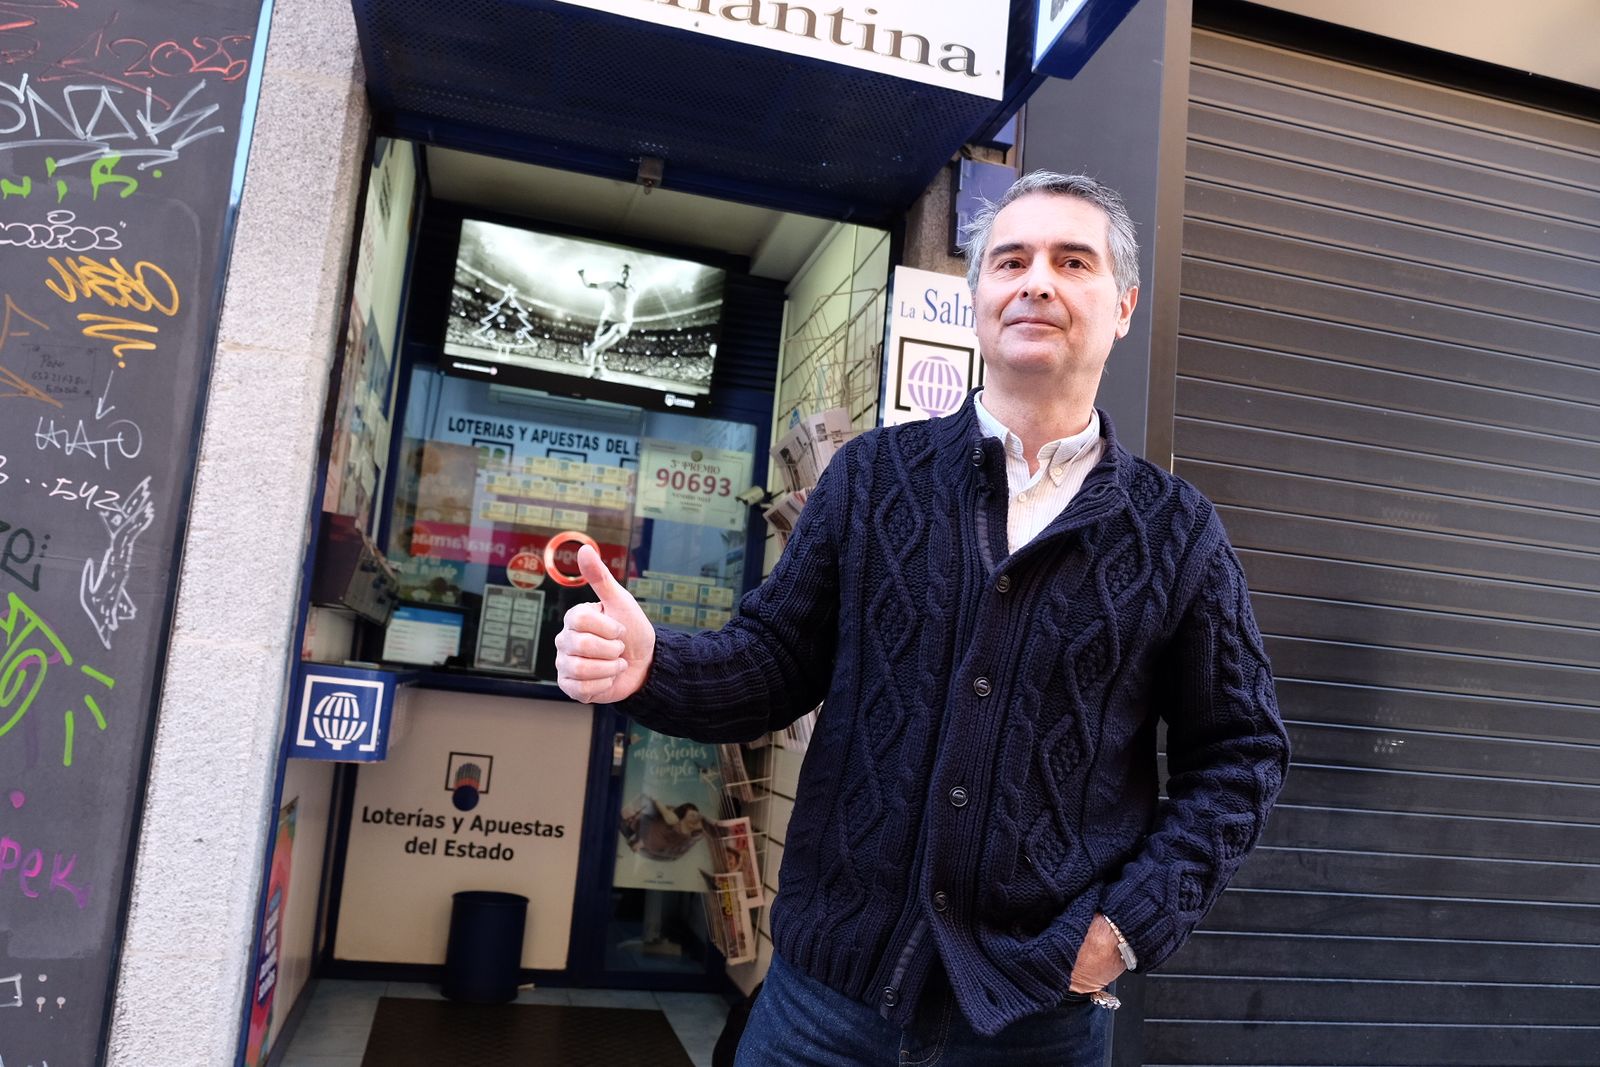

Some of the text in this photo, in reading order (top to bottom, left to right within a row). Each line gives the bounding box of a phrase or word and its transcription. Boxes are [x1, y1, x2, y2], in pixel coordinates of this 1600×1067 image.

[640, 0, 983, 78] antina
[900, 301, 916, 319] La
[448, 416, 514, 440] LOTERIAS
[519, 426, 529, 441] Y
[531, 428, 600, 451] APUESTAS
[606, 438, 630, 455] DEL
[655, 467, 732, 497] 90693
[361, 806, 565, 838] Loterías y Apuestas
[404, 836, 515, 862] del Estado
